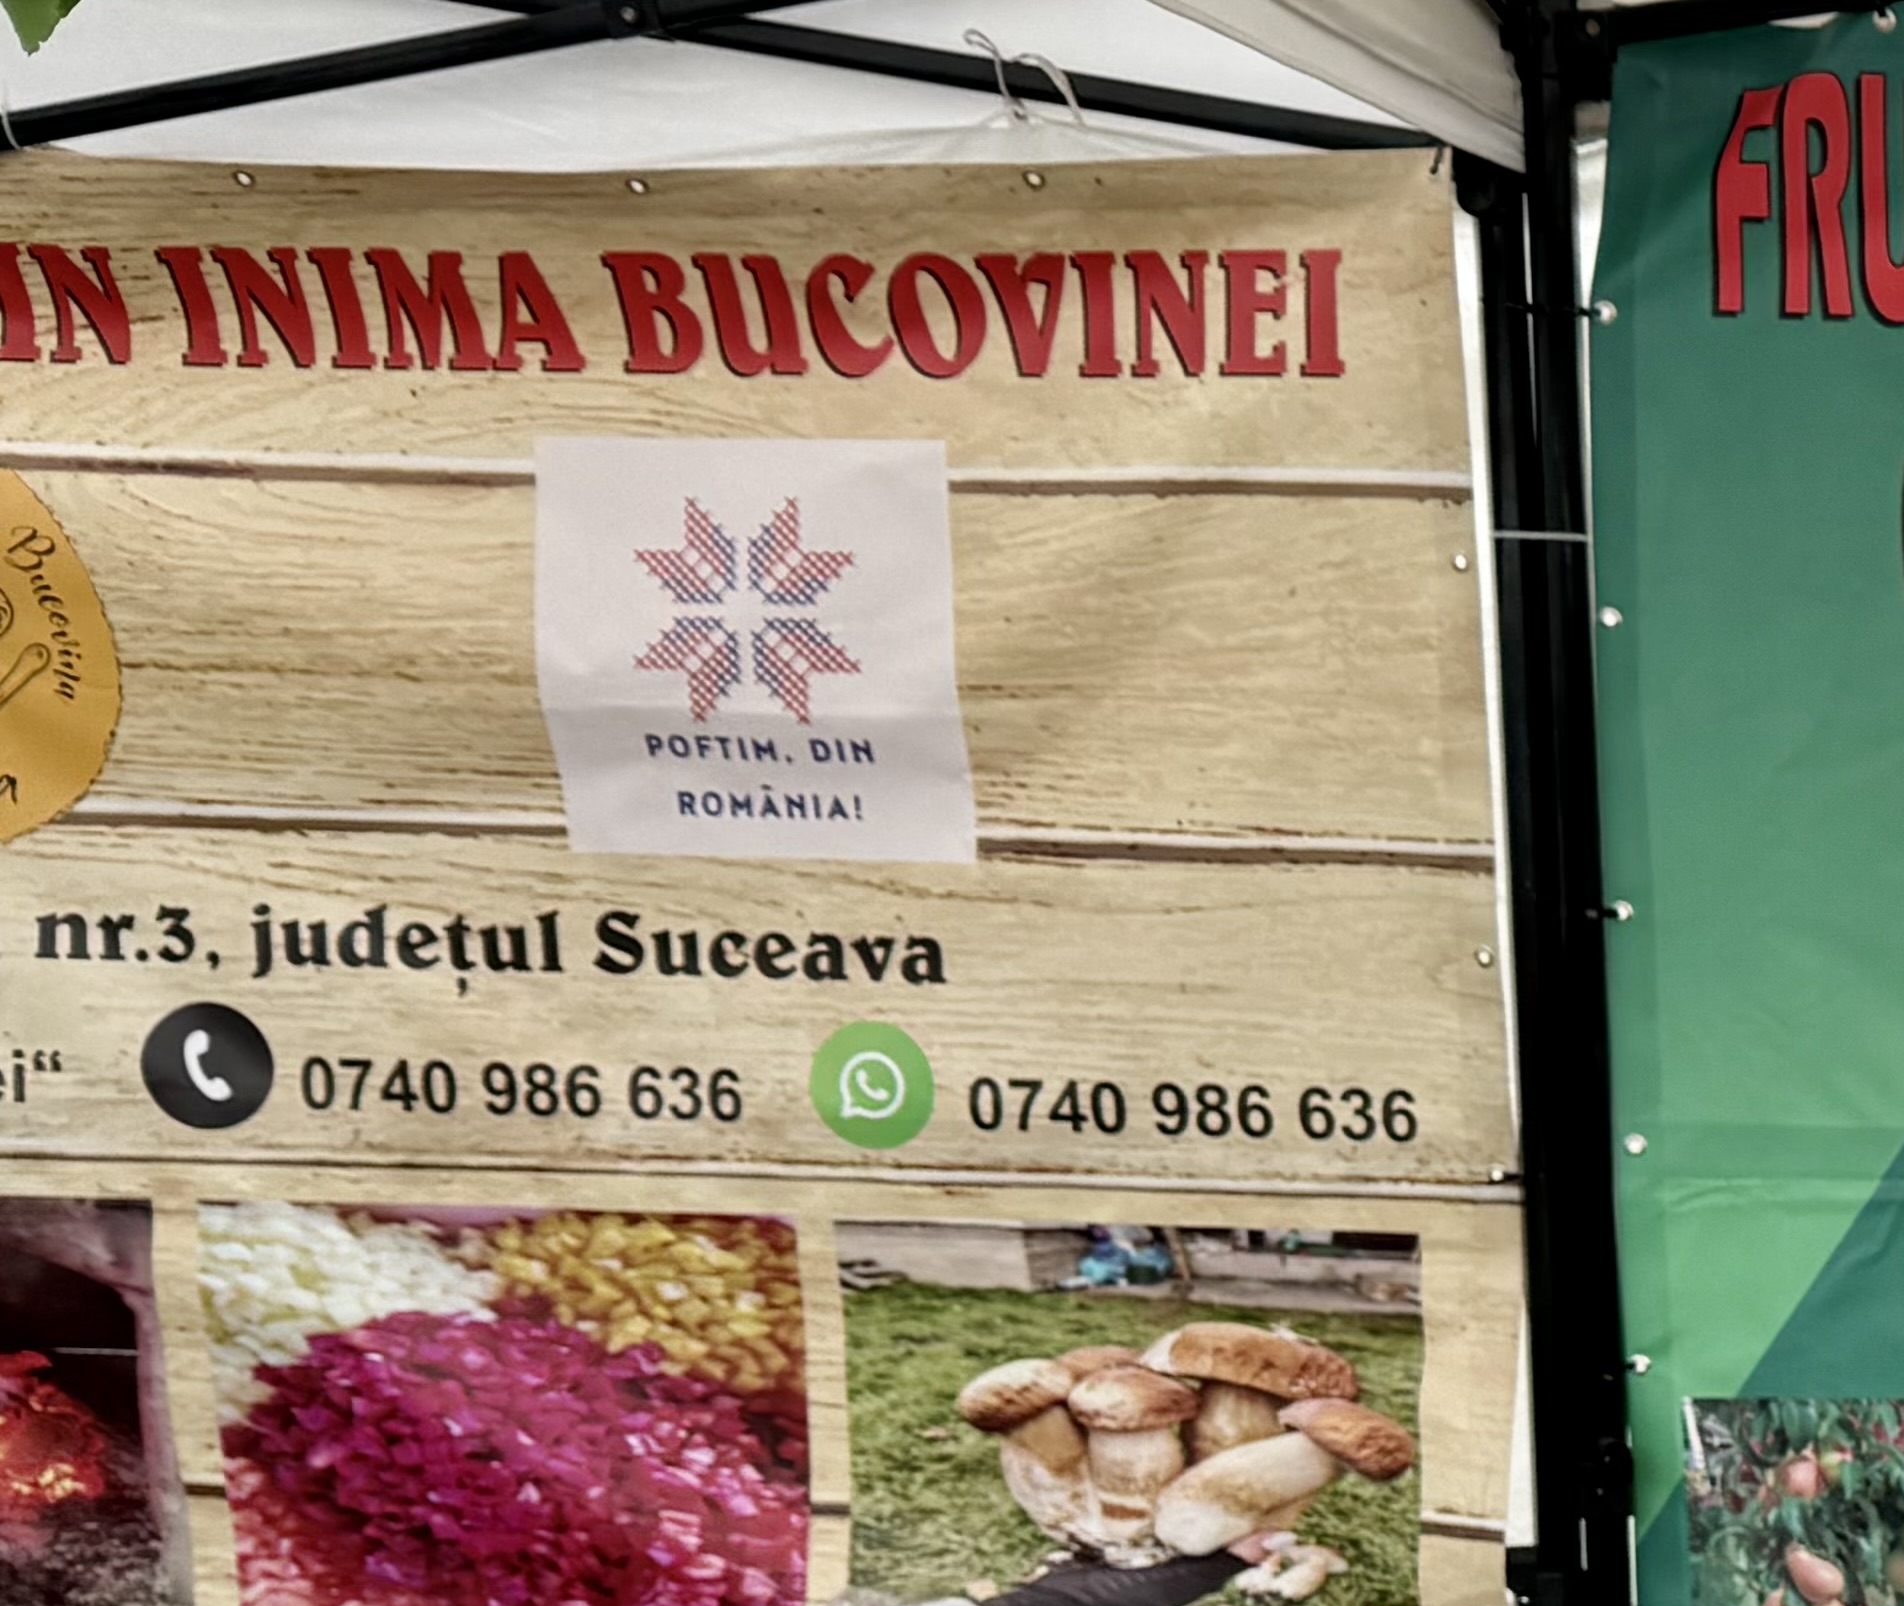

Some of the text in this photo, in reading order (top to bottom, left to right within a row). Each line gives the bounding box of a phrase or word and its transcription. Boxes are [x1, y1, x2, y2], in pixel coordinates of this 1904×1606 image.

[156, 244, 587, 373] INIMA
[601, 249, 1345, 379] BUCOVINEI
[809, 738, 876, 763] DIN
[677, 784, 864, 820] ROMÂNIA!
[34, 902, 948, 996] nr.3, județul Suceava
[300, 1055, 458, 1114] 0740
[483, 1060, 601, 1118] 986
[627, 1066, 742, 1123] 636
[969, 1077, 1418, 1142] 0740 986 636
